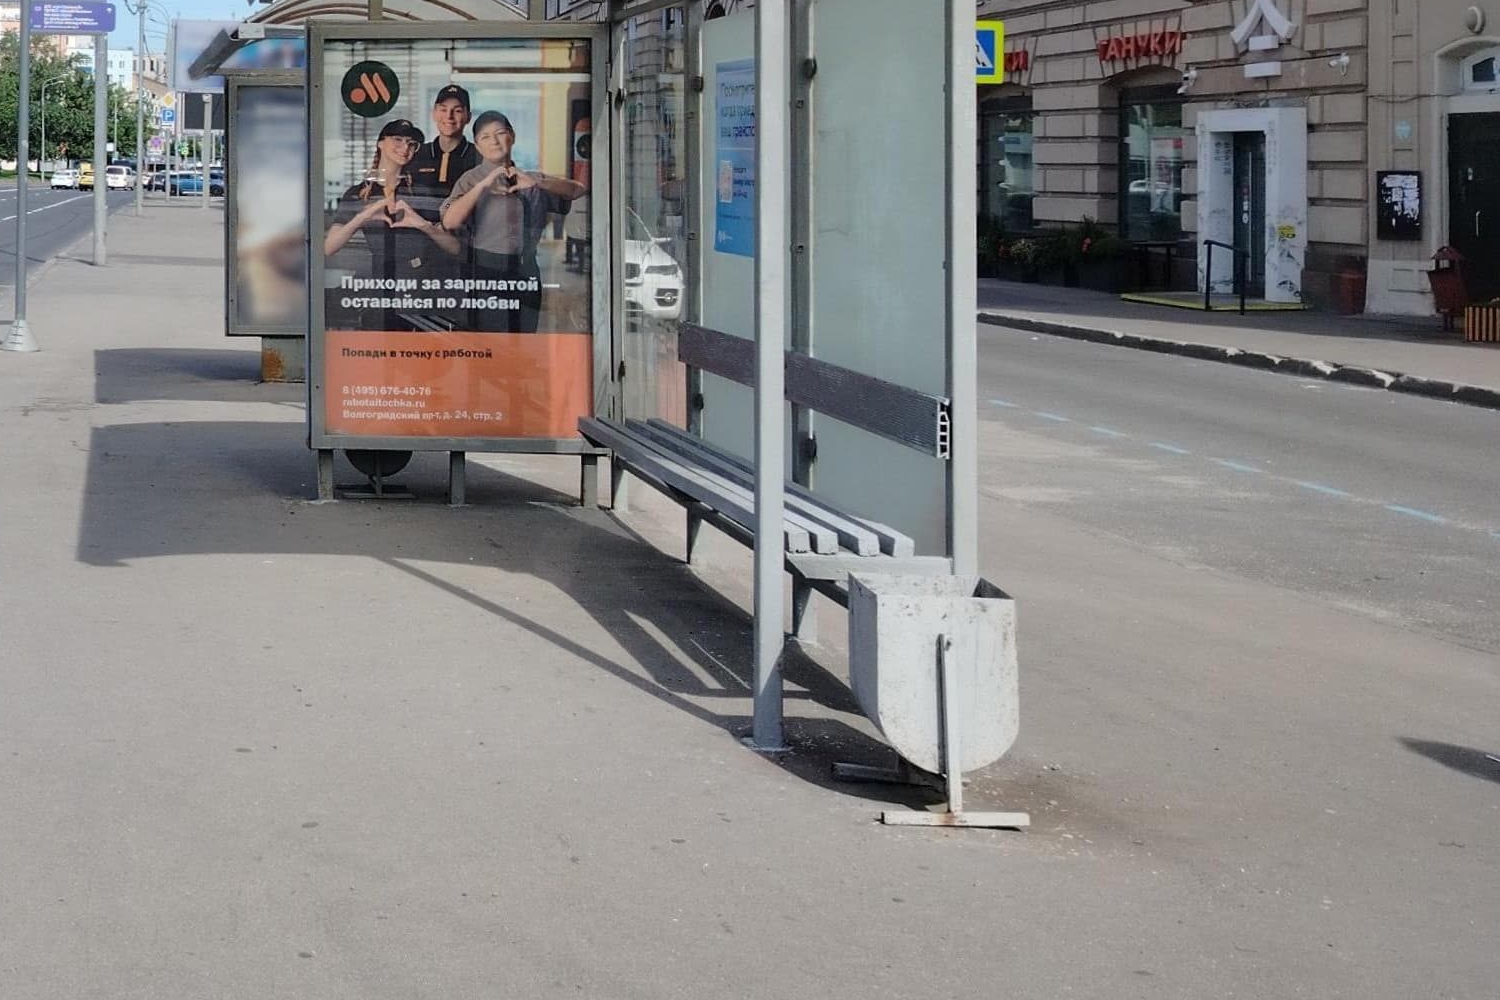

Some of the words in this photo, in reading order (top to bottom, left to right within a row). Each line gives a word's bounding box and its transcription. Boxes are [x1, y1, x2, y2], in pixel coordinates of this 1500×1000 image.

[1097, 32, 1182, 61] ТАНУКИ
[341, 276, 417, 292] Приходи
[421, 279, 441, 290] за
[444, 276, 539, 292] зарплатой
[341, 295, 433, 309] оставайся
[436, 297, 456, 309] по
[460, 296, 520, 310] любви
[342, 348, 387, 359] Попади
[389, 350, 397, 358] в
[399, 350, 433, 360] точку
[435, 350, 441, 358] с
[443, 348, 493, 359] работой
[351, 386, 378, 396] (495)
[342, 399, 426, 409] rabotaitochka.ru
[343, 409, 420, 421] Волгоградский
[473, 412, 494, 422] стр.
[495, 411, 503, 421] 2
